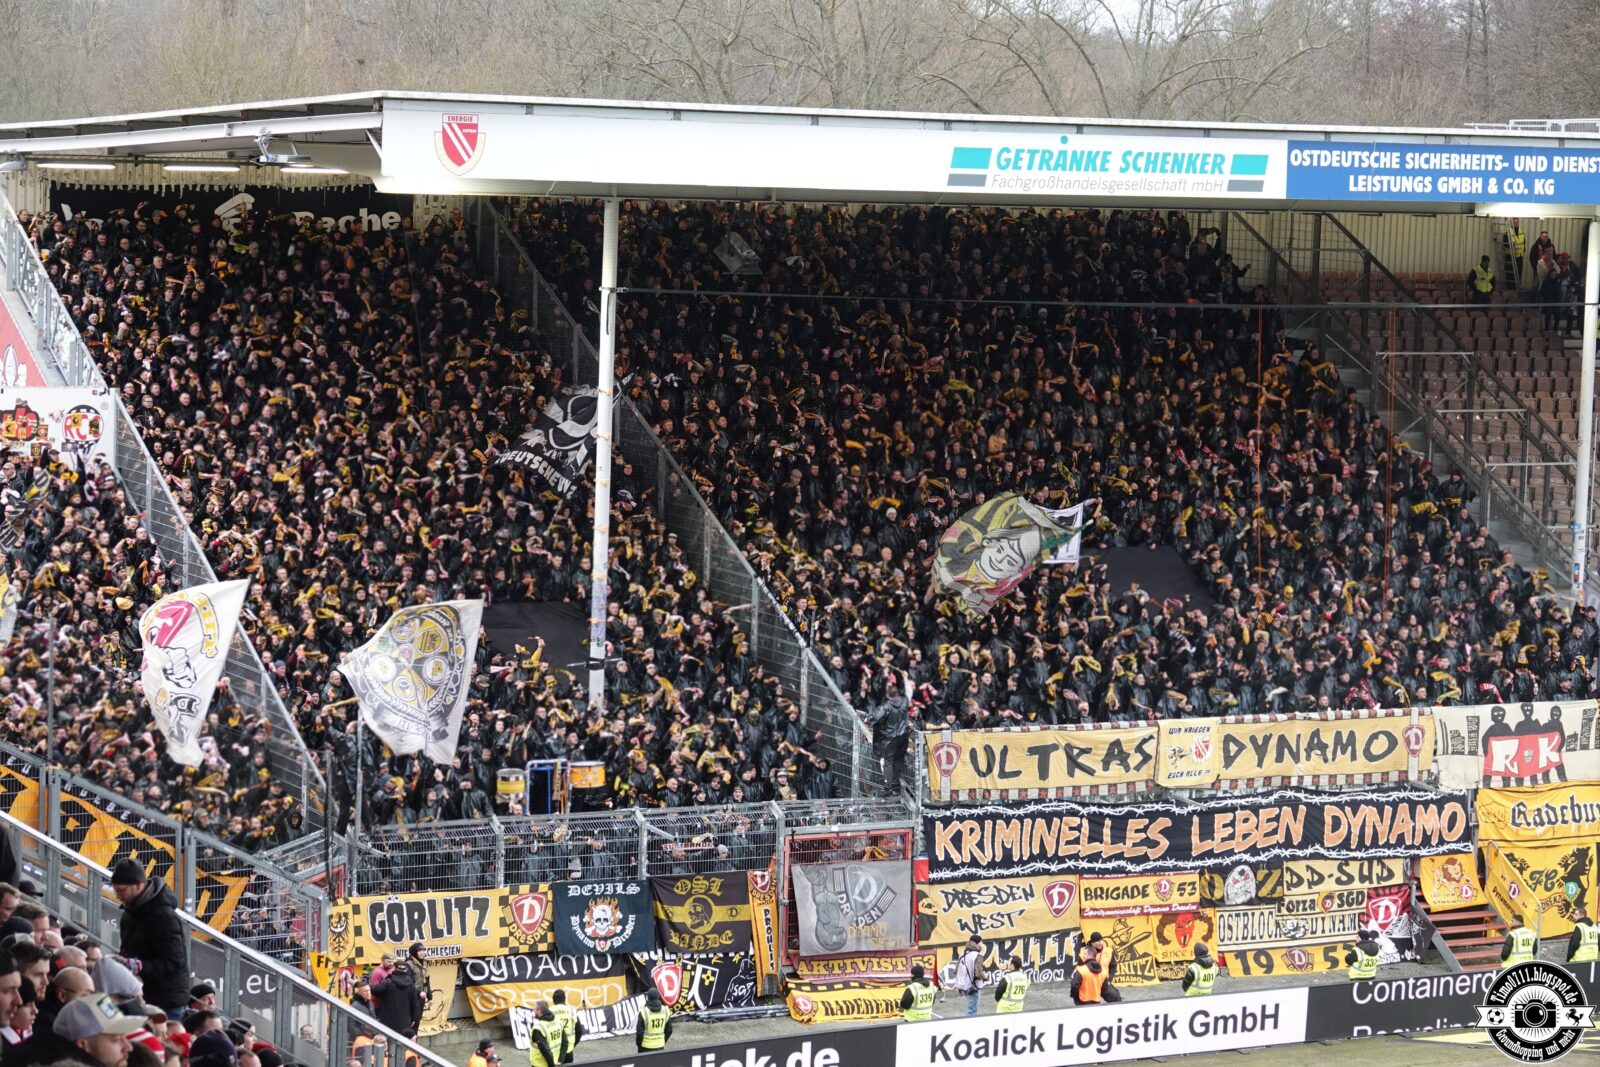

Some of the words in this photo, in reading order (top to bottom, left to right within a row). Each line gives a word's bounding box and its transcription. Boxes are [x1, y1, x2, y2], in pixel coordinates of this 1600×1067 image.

[1119, 149, 1226, 175] SCHENKER
[1289, 148, 1400, 169] OSTDEUTSCHE
[1405, 152, 1509, 171] SICHERHEITS-
[1514, 155, 1548, 172] UND
[991, 173, 1188, 194] Fachgroßhandelsgesellschaft
[1191, 178, 1223, 193] mbH
[1349, 174, 1432, 193] LEISTUNGS
[1437, 177, 1483, 194] GMBH
[1487, 178, 1499, 194] &
[1503, 178, 1528, 195] CO.
[1534, 178, 1555, 195] KG
[969, 734, 1155, 781] ULTRAS
[1222, 728, 1398, 769] DYNAMO
[1511, 794, 1600, 829] Radebu
[934, 816, 1173, 866] KRIMINELLES
[1190, 804, 1307, 858] LEBEN
[1323, 801, 1466, 850] DYNAMO
[567, 882, 641, 898] DEVILS
[939, 883, 1036, 913] DRESDEN
[1083, 883, 1151, 902] BRIGADE
[1176, 881, 1198, 897] 53
[1276, 897, 1317, 914] Forza
[1337, 890, 1366, 908] SGD
[367, 895, 491, 944] GÖRLITZ
[956, 908, 1026, 935] WEST
[1142, 904, 1170, 914] Dynamo
[508, 917, 550, 945] DRESDEN
[570, 914, 595, 949] Dynamo
[610, 913, 637, 948] Dresden
[1310, 912, 1361, 935] DYNAM
[669, 930, 736, 951] BANDE
[461, 953, 613, 983] DYNAMO
[797, 956, 908, 975] AKTIVIST
[1234, 949, 1275, 976] 19
[919, 992, 932, 1004] 339
[1013, 984, 1025, 995] 276
[650, 1018, 664, 1029] 137
[929, 1025, 1046, 1063] Koalick
[1056, 1013, 1178, 1054] Logistik
[1188, 1003, 1281, 1037] GmbH
